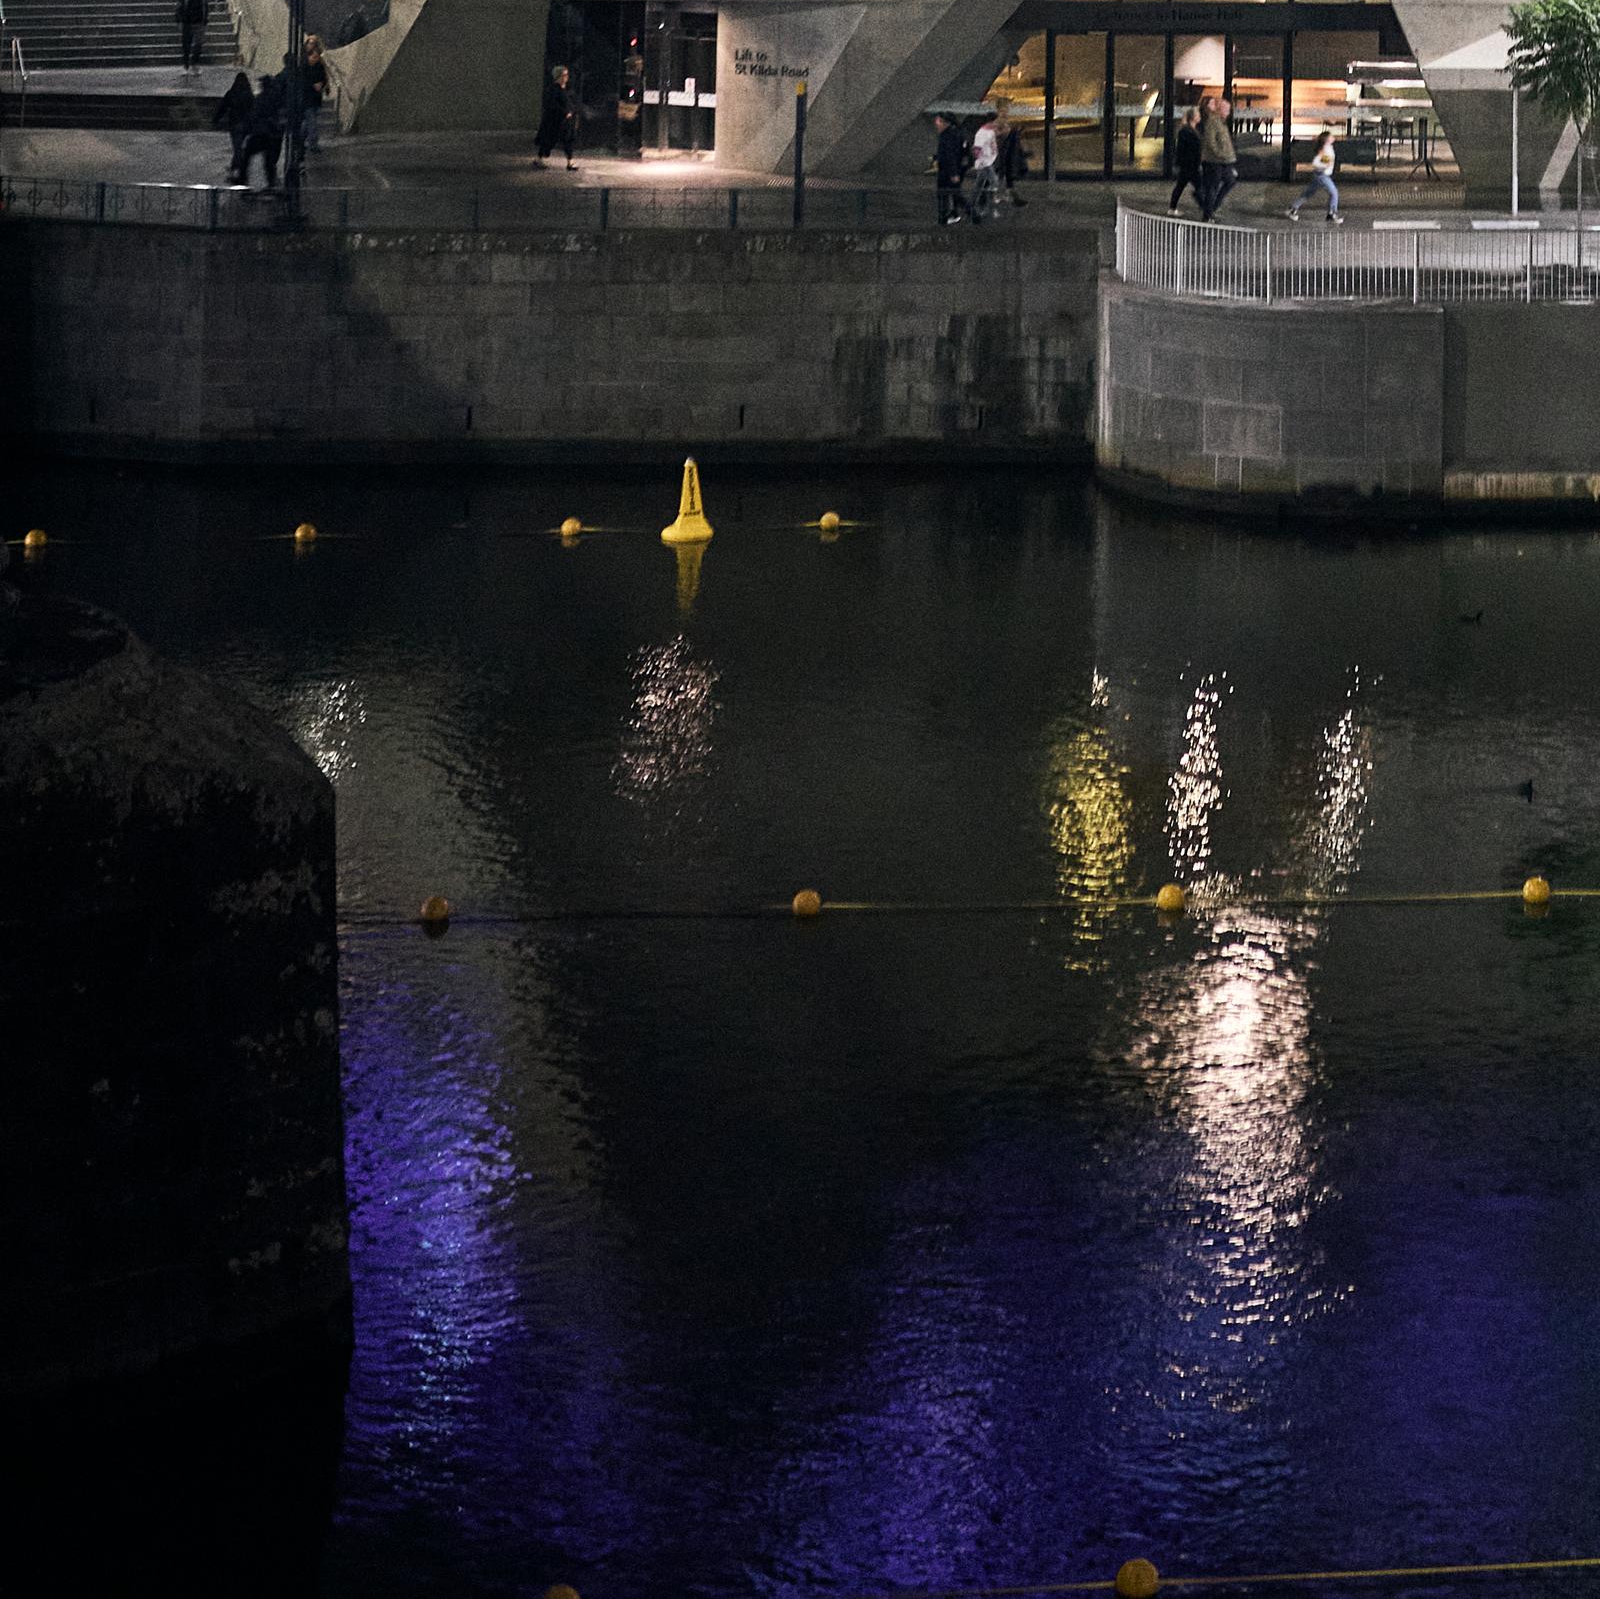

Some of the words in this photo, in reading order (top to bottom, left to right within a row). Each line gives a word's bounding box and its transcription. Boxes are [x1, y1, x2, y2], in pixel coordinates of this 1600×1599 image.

[735, 48, 752, 61] Lift
[750, 64, 778, 76] Kilda
[781, 65, 809, 77] Road
